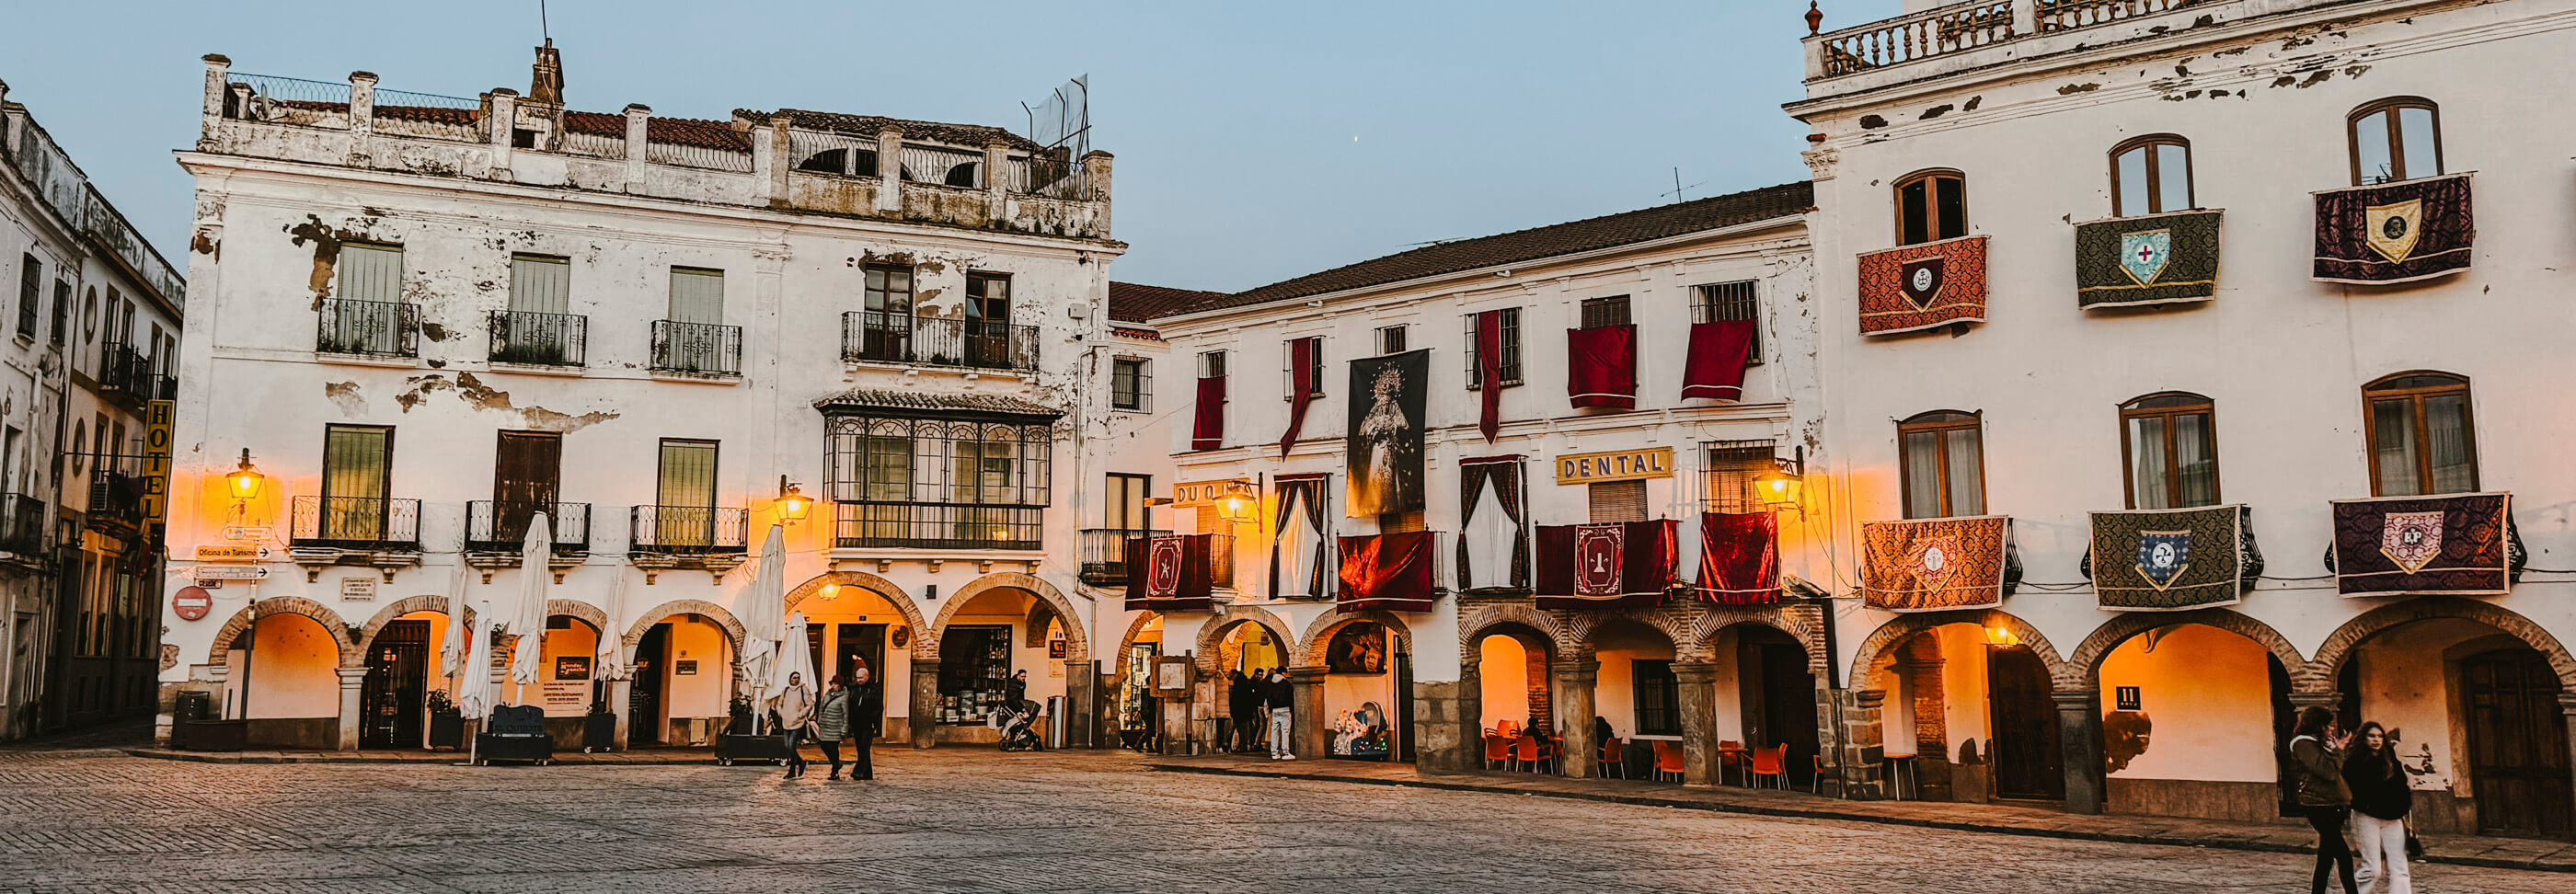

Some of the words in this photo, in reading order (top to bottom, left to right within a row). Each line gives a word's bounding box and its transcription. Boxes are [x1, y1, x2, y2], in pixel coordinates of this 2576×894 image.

[144, 404, 168, 519] HOTEL
[1565, 453, 1664, 478] DENTAL
[199, 548, 221, 556] Oficina
[222, 548, 231, 556] de
[232, 548, 257, 556] Turismo
